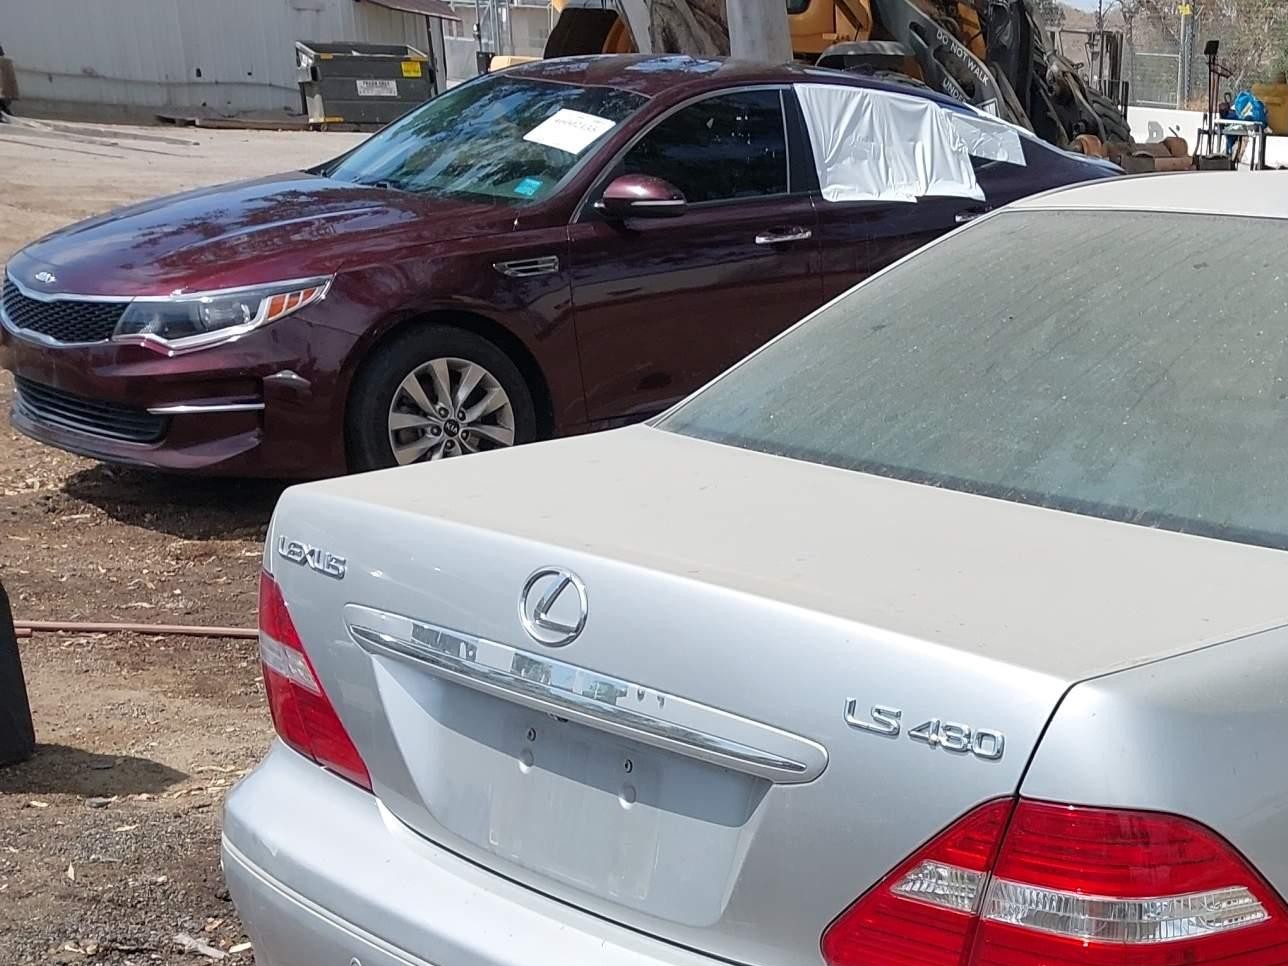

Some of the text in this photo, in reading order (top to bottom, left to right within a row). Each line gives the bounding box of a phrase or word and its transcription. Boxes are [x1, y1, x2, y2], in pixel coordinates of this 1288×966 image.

[936, 29, 989, 86] DO NOT WALK
[279, 535, 346, 580] LEXUS
[844, 697, 1005, 762] LS 430
